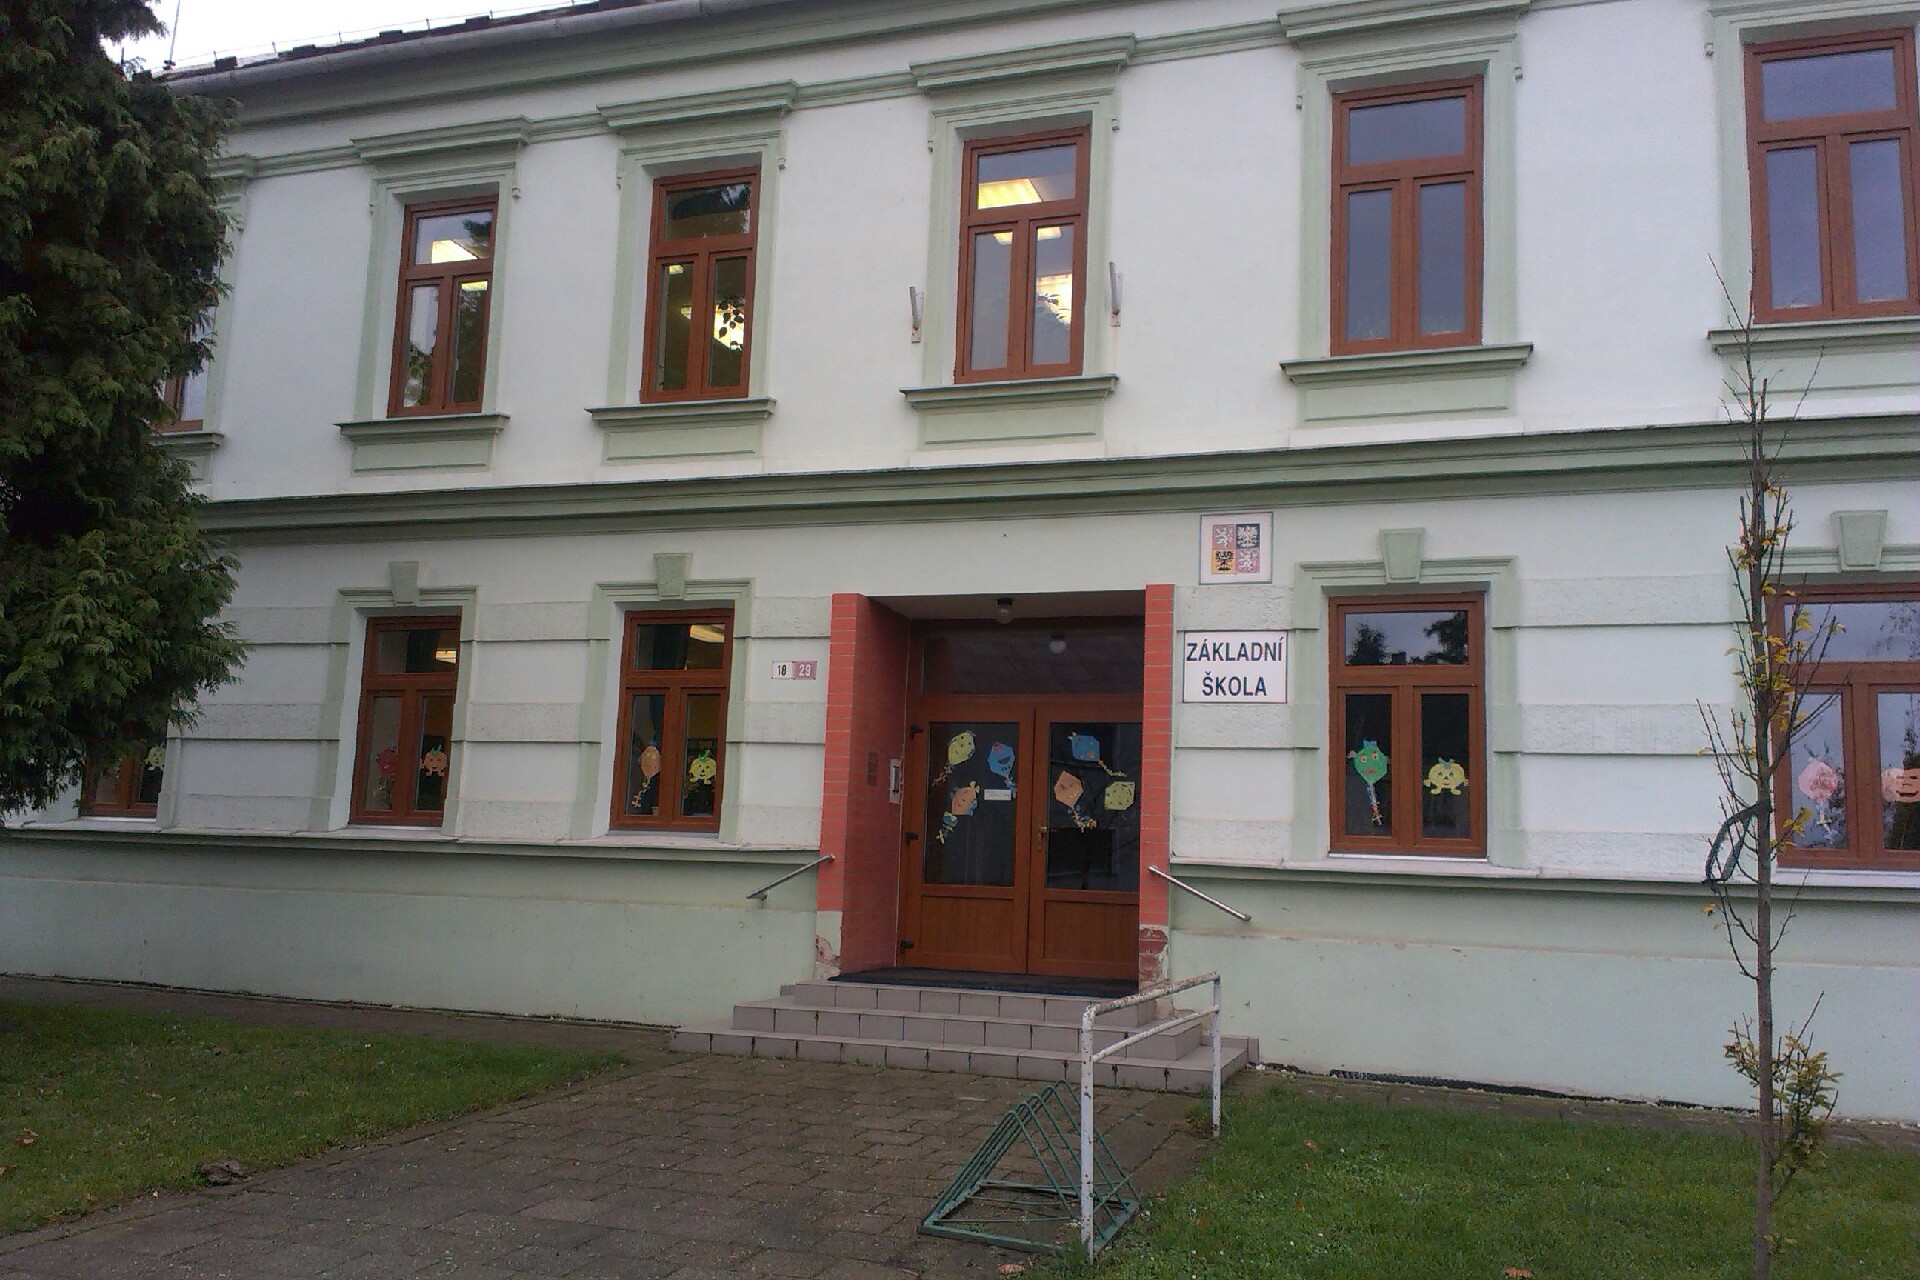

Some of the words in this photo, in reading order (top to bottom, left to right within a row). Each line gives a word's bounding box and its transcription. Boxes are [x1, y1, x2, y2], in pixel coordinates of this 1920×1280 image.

[1186, 637, 1284, 662] ZÁKLADNÍ
[798, 664, 811, 677] 29
[1202, 671, 1267, 697] ŠKOLA
